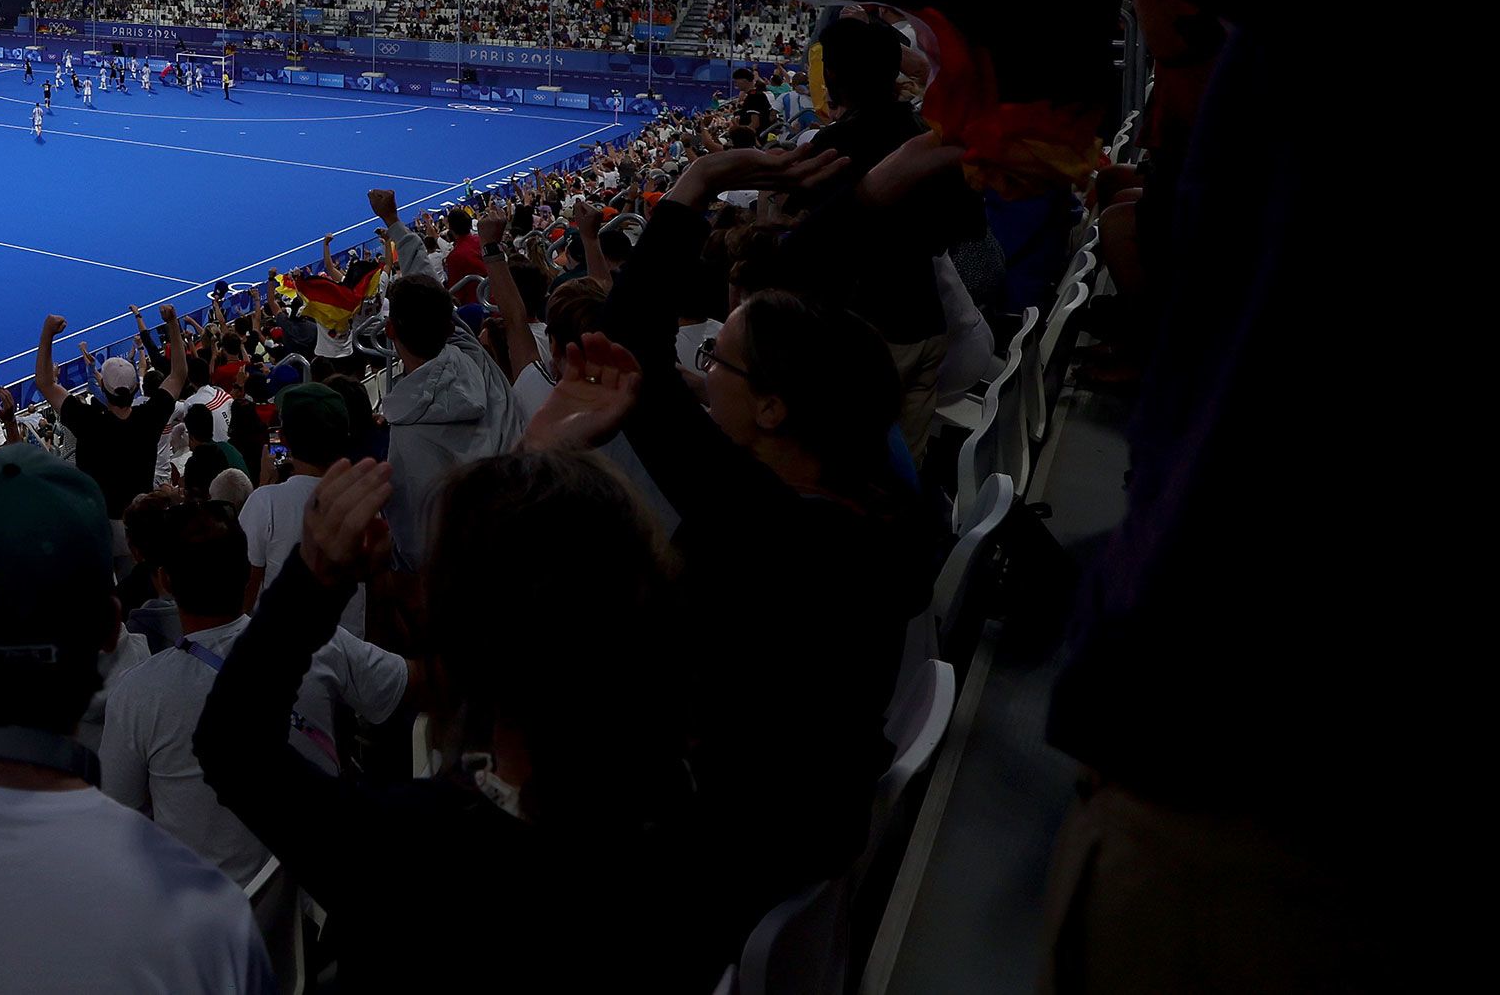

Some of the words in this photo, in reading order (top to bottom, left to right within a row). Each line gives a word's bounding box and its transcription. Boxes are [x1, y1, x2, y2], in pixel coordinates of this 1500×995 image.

[112, 26, 143, 38] PARIS
[147, 29, 177, 39] 2024
[469, 49, 515, 62] PARIS
[521, 53, 564, 66] 2024
